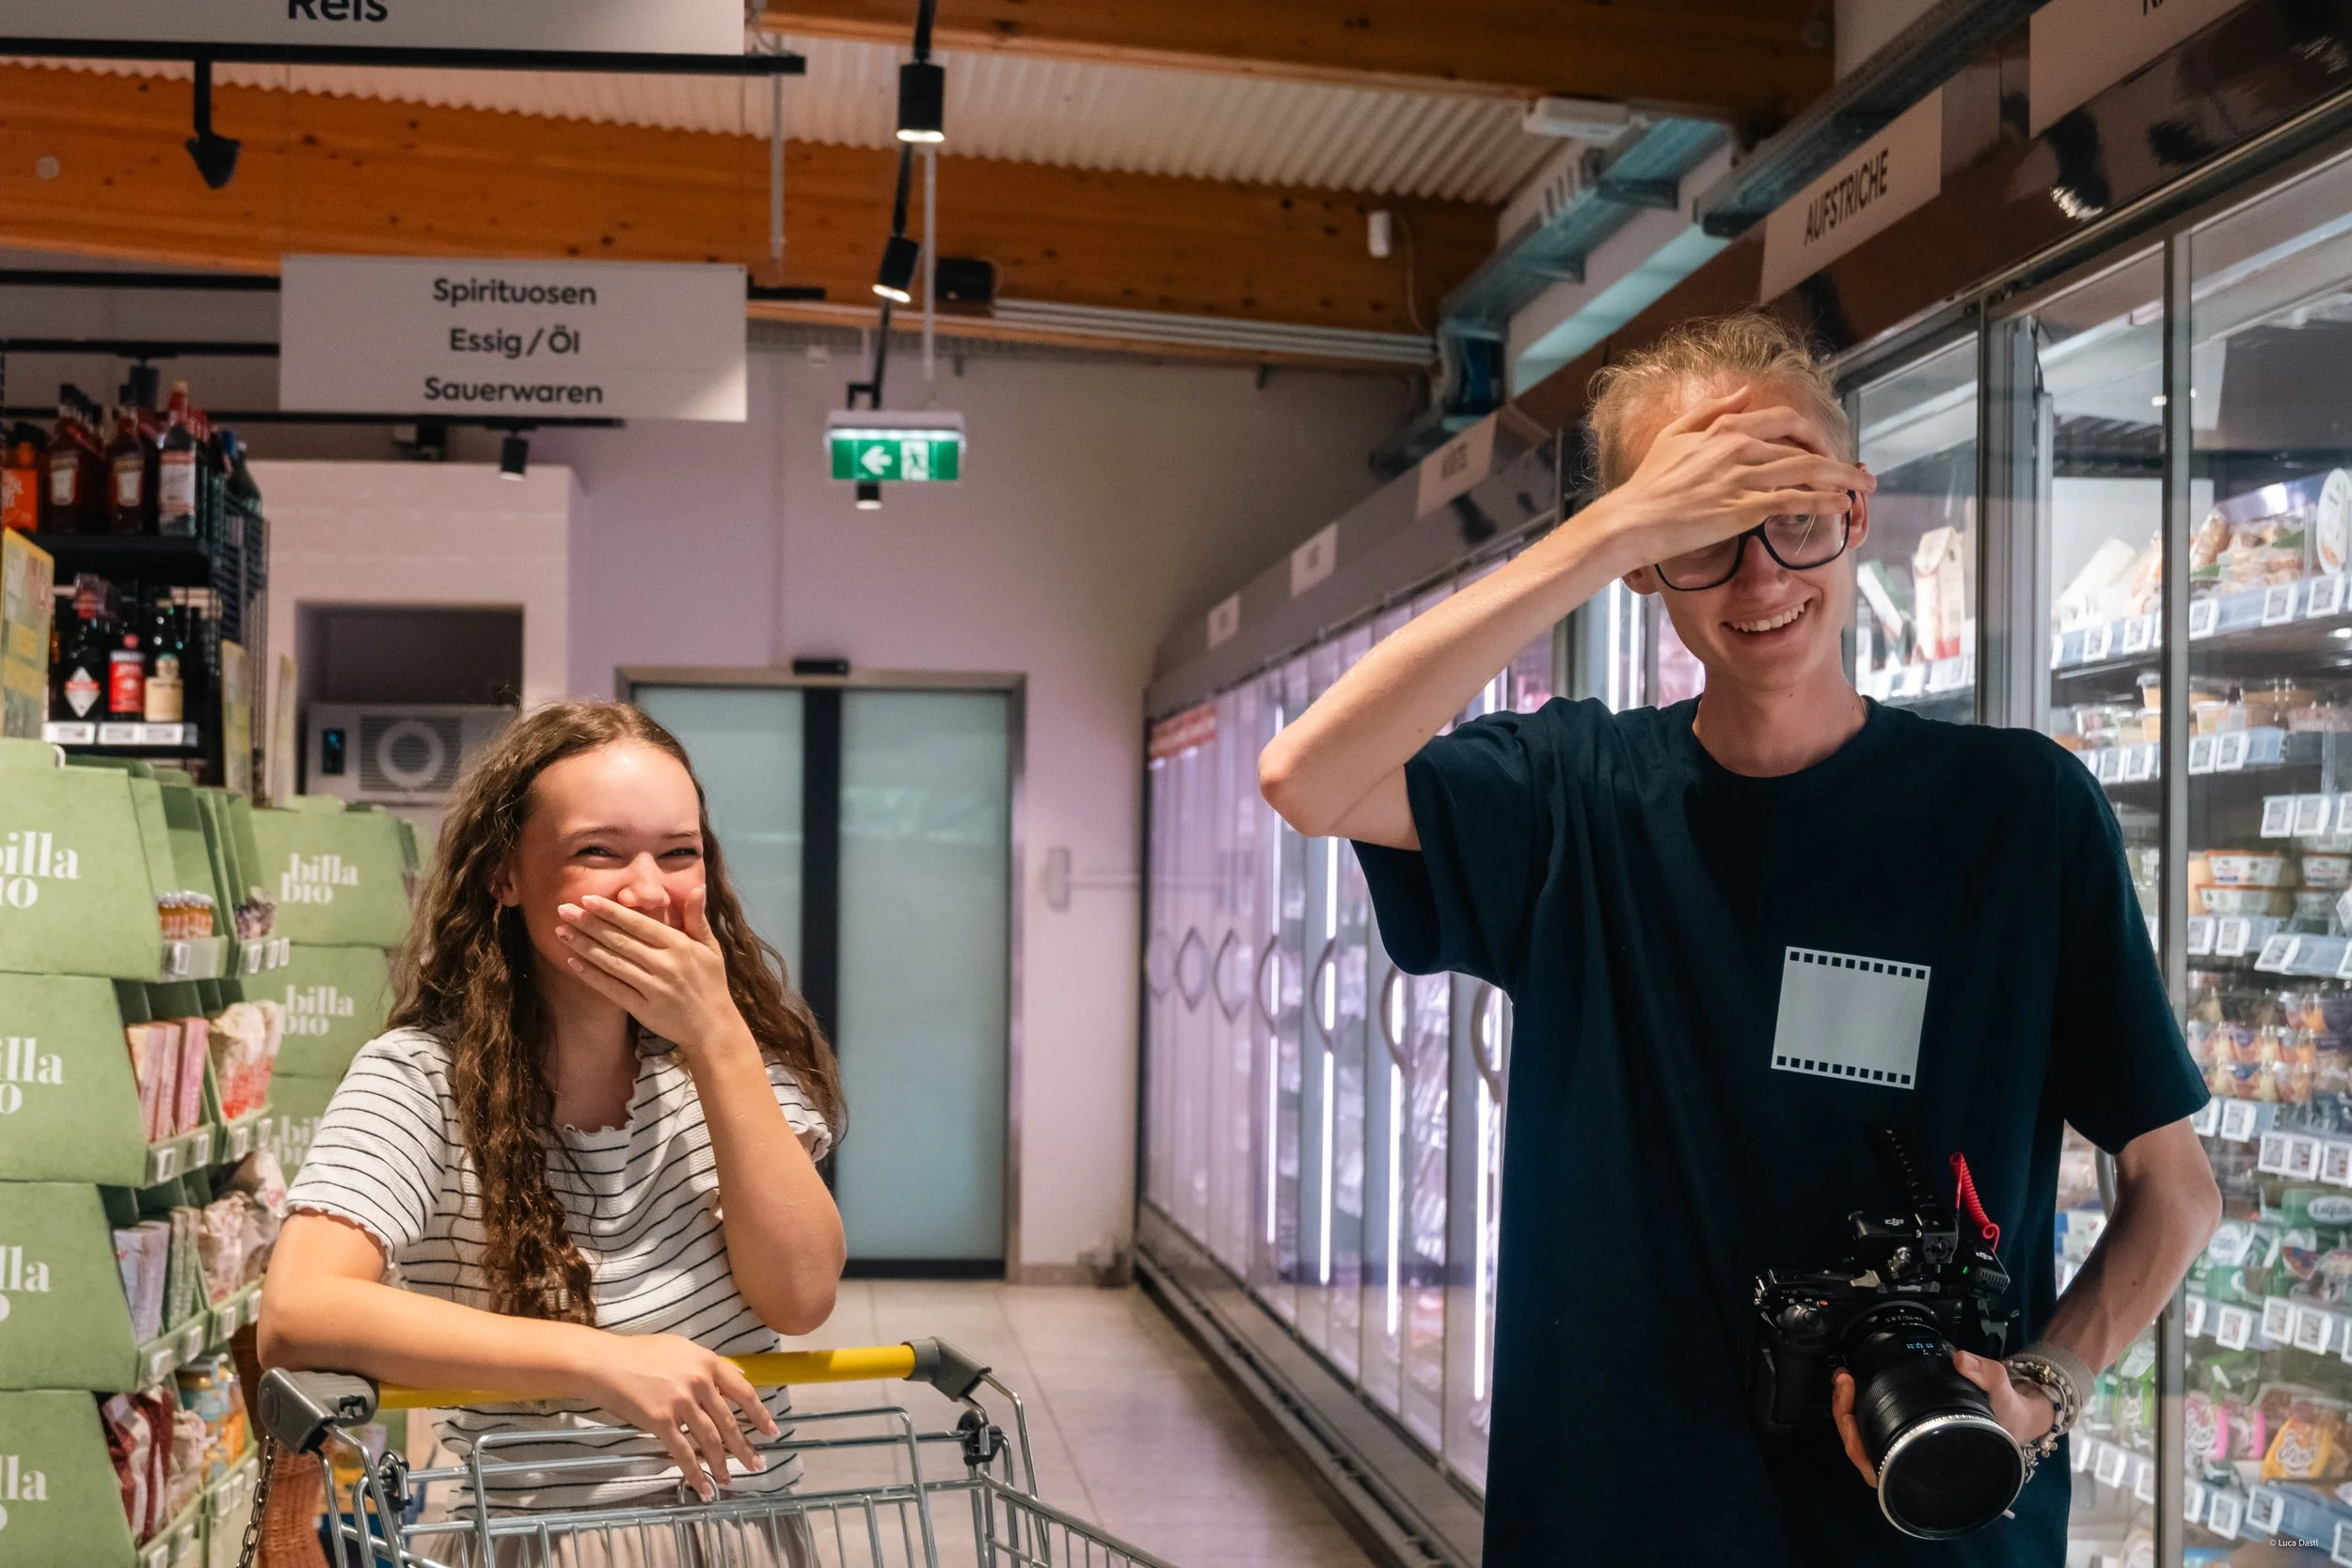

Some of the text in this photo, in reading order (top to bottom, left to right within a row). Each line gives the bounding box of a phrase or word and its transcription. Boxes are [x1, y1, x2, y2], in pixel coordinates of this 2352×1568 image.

[1804, 148, 1888, 246] AUFSTRICHE
[433, 277, 596, 308] Spirituosen
[424, 376, 603, 404] Sauerwaren
[0, 832, 81, 879] illa
[290, 853, 358, 885] billa
[281, 872, 333, 904] bio
[286, 985, 354, 1017] billa
